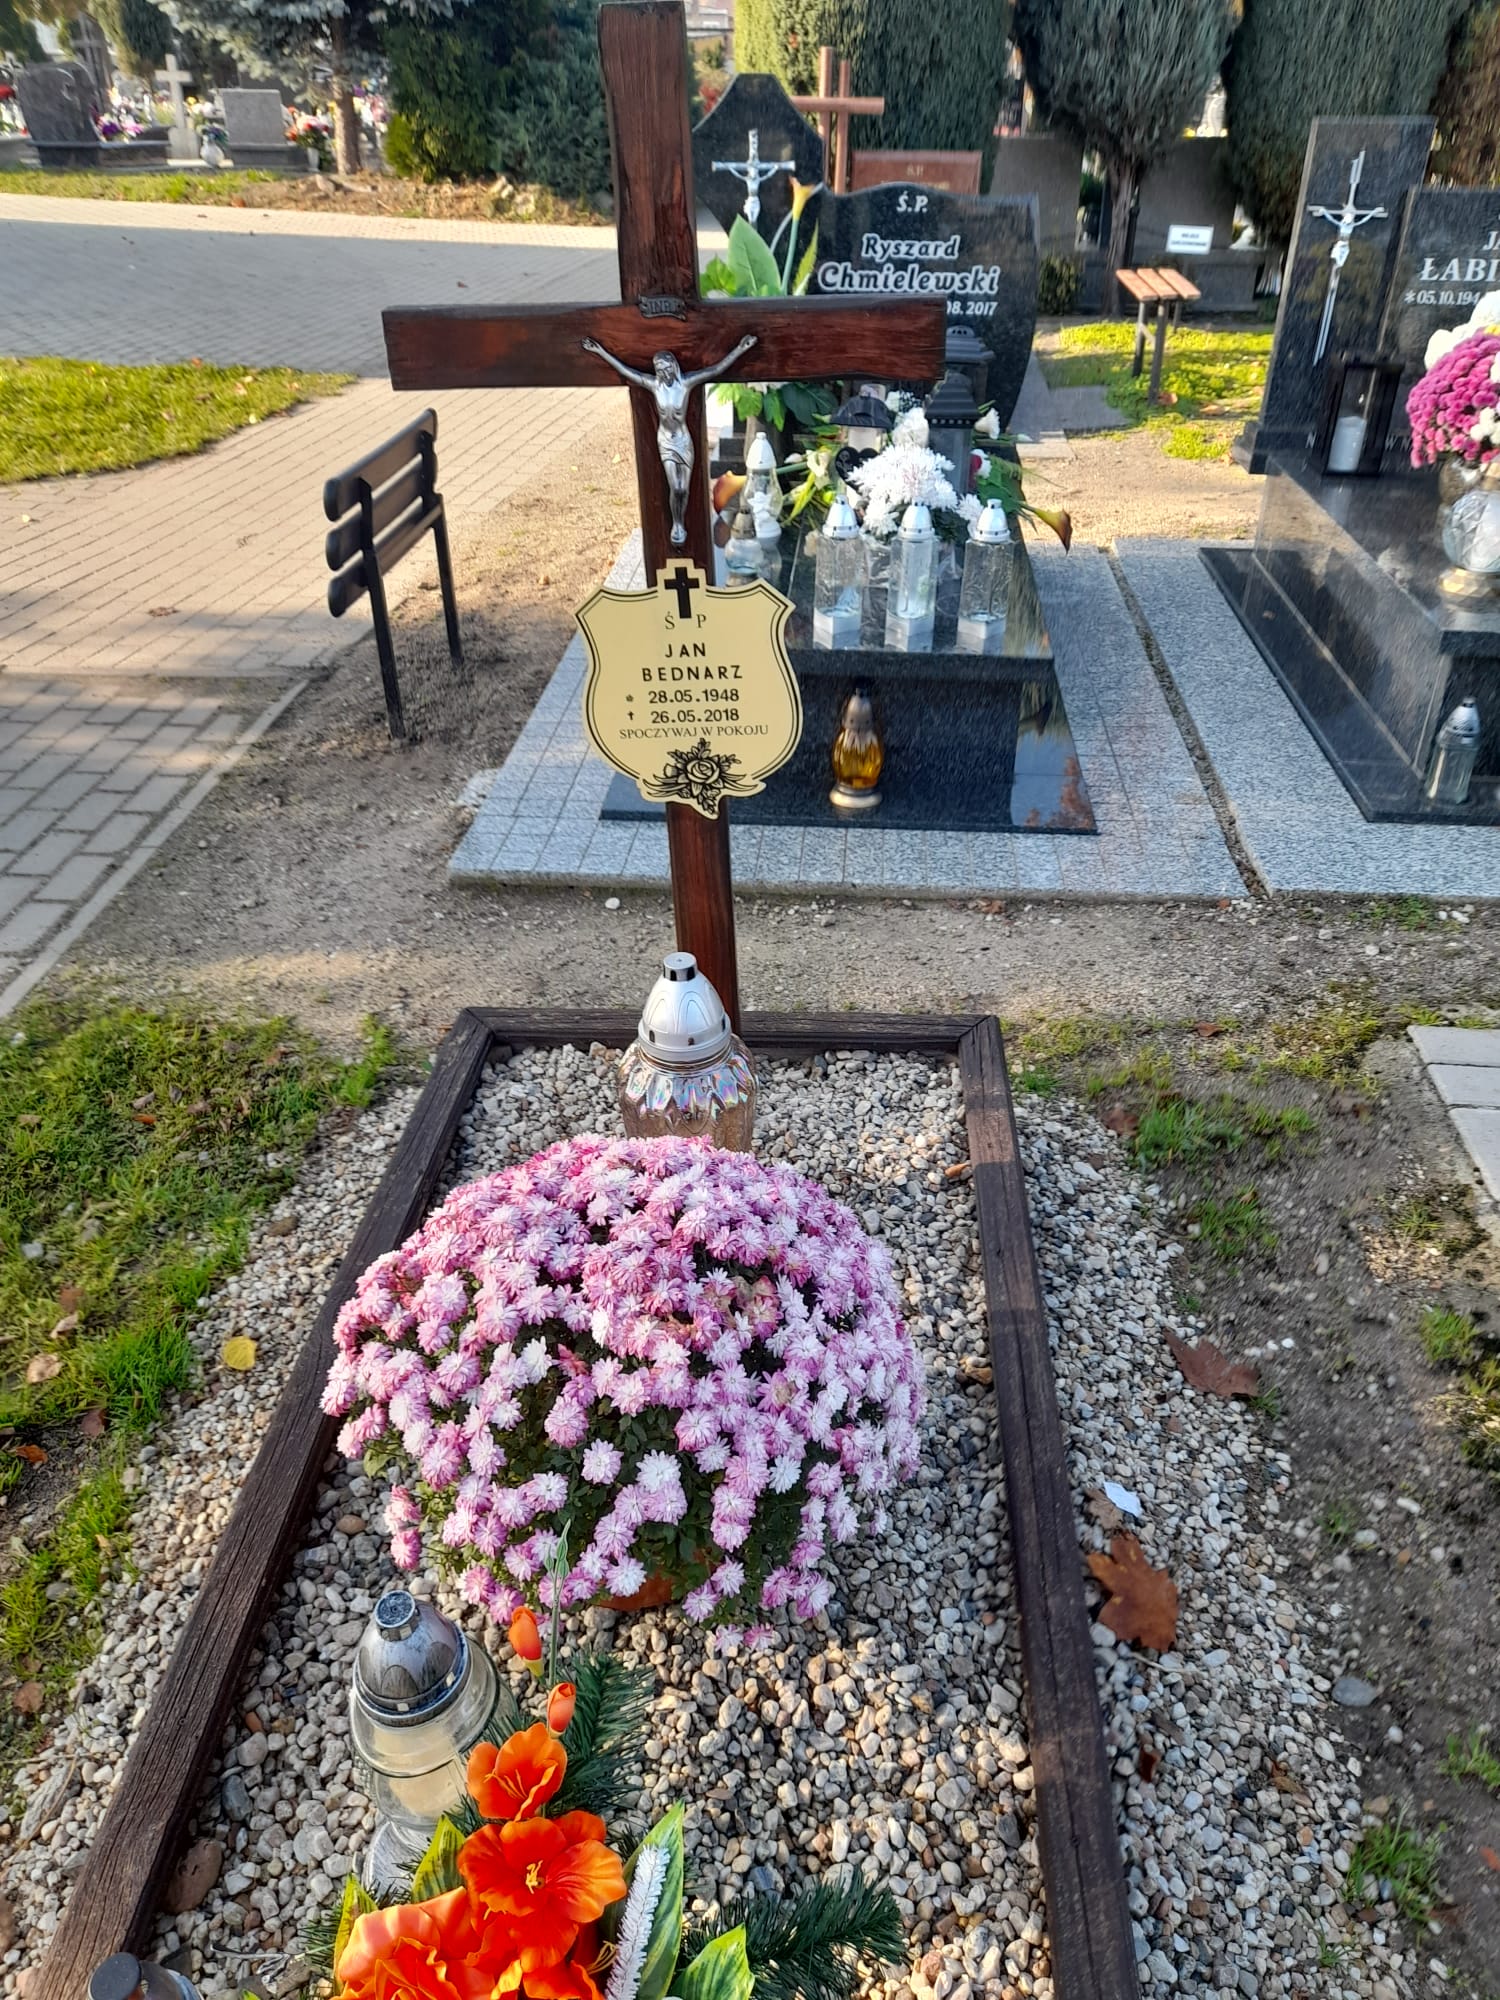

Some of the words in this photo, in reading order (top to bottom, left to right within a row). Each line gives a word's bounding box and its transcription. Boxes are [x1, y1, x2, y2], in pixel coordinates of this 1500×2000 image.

[861, 233, 961, 262] Ryszard
[818, 262, 1001, 294] Chmielewski
[1416, 257, 1500, 282] ŁABI
[664, 611, 676, 630] Ś
[696, 614, 707, 629] P
[664, 642, 706, 659] JAN
[641, 665, 743, 683] BEDNARZ
[648, 688, 740, 704] 28.05.1948
[650, 708, 740, 724] 26.05.2018
[619, 727, 697, 739] SPOCZYWAJ
[700, 726, 714, 738] W
[716, 725, 769, 737] POKOJU
